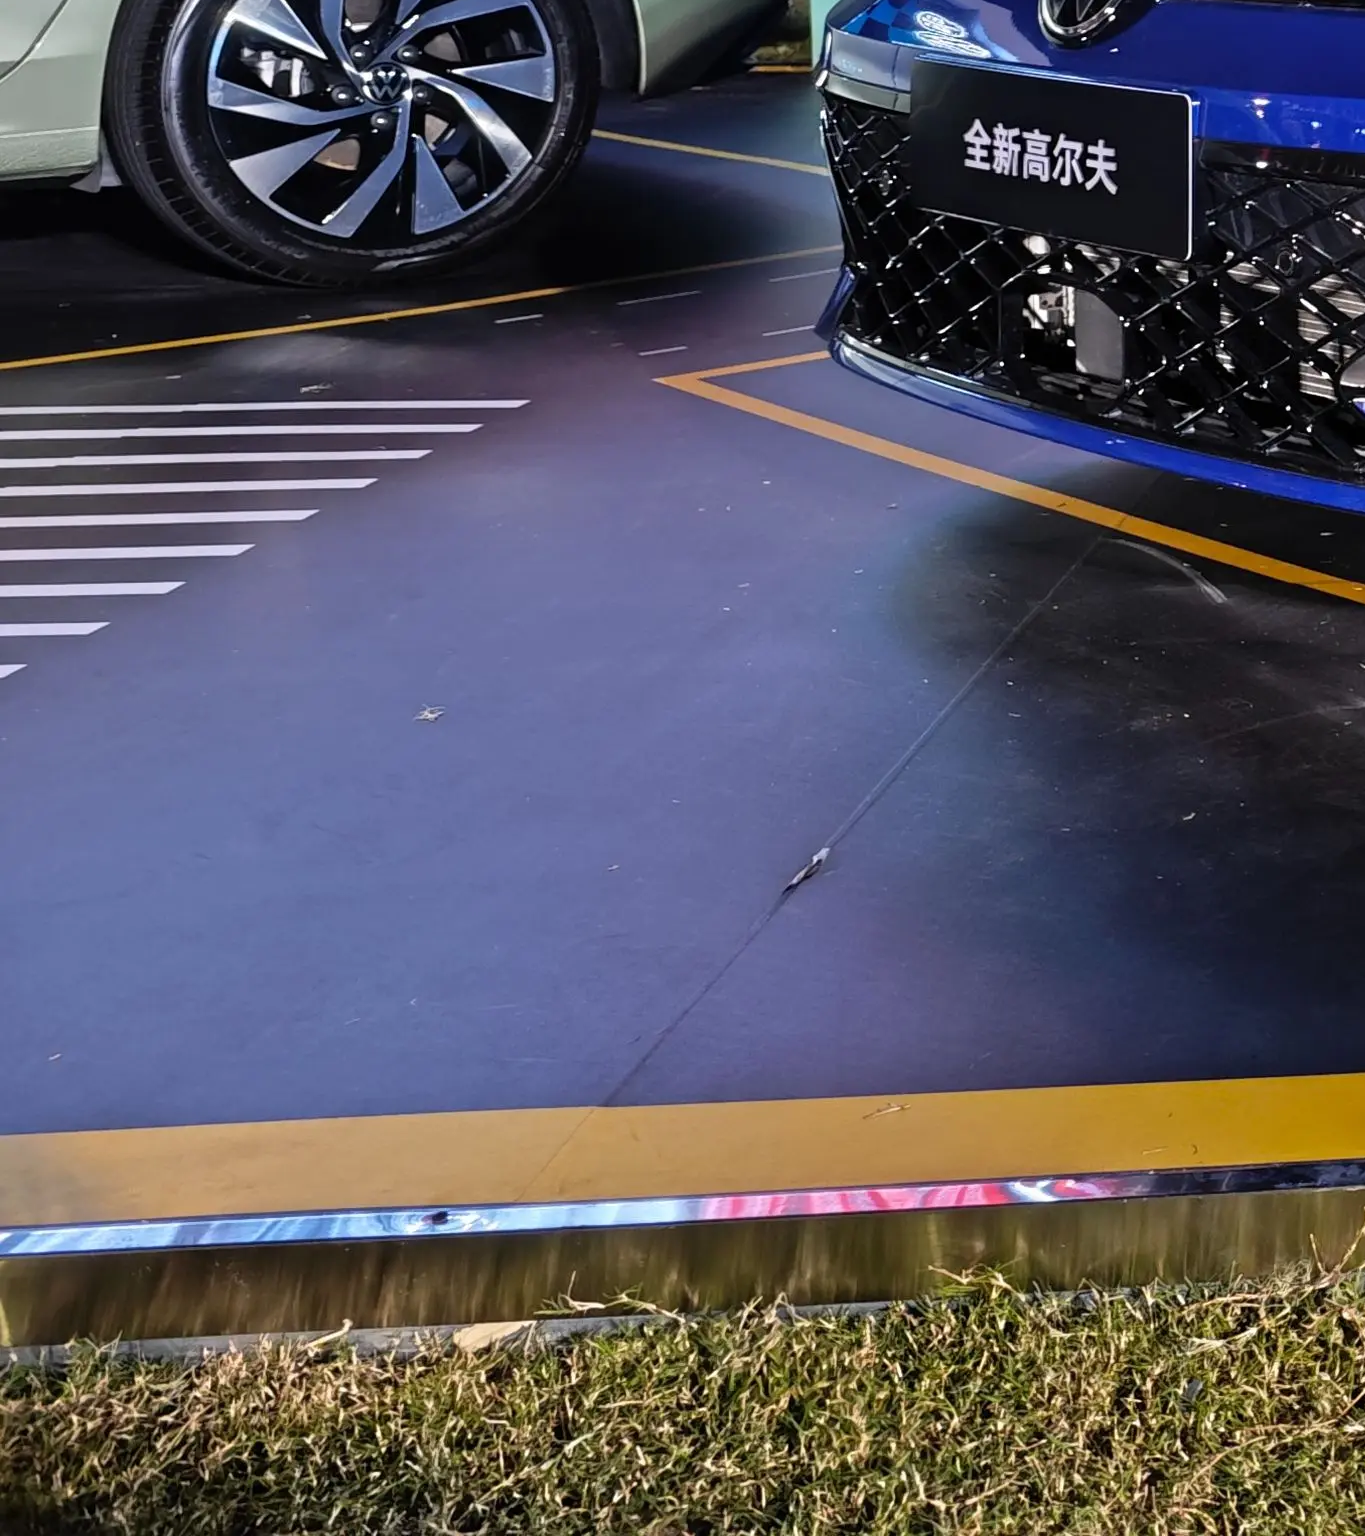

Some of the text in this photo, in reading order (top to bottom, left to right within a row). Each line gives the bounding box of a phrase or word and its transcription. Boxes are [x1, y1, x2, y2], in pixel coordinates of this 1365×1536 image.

[963, 118, 1118, 195] 全新高尔夫
